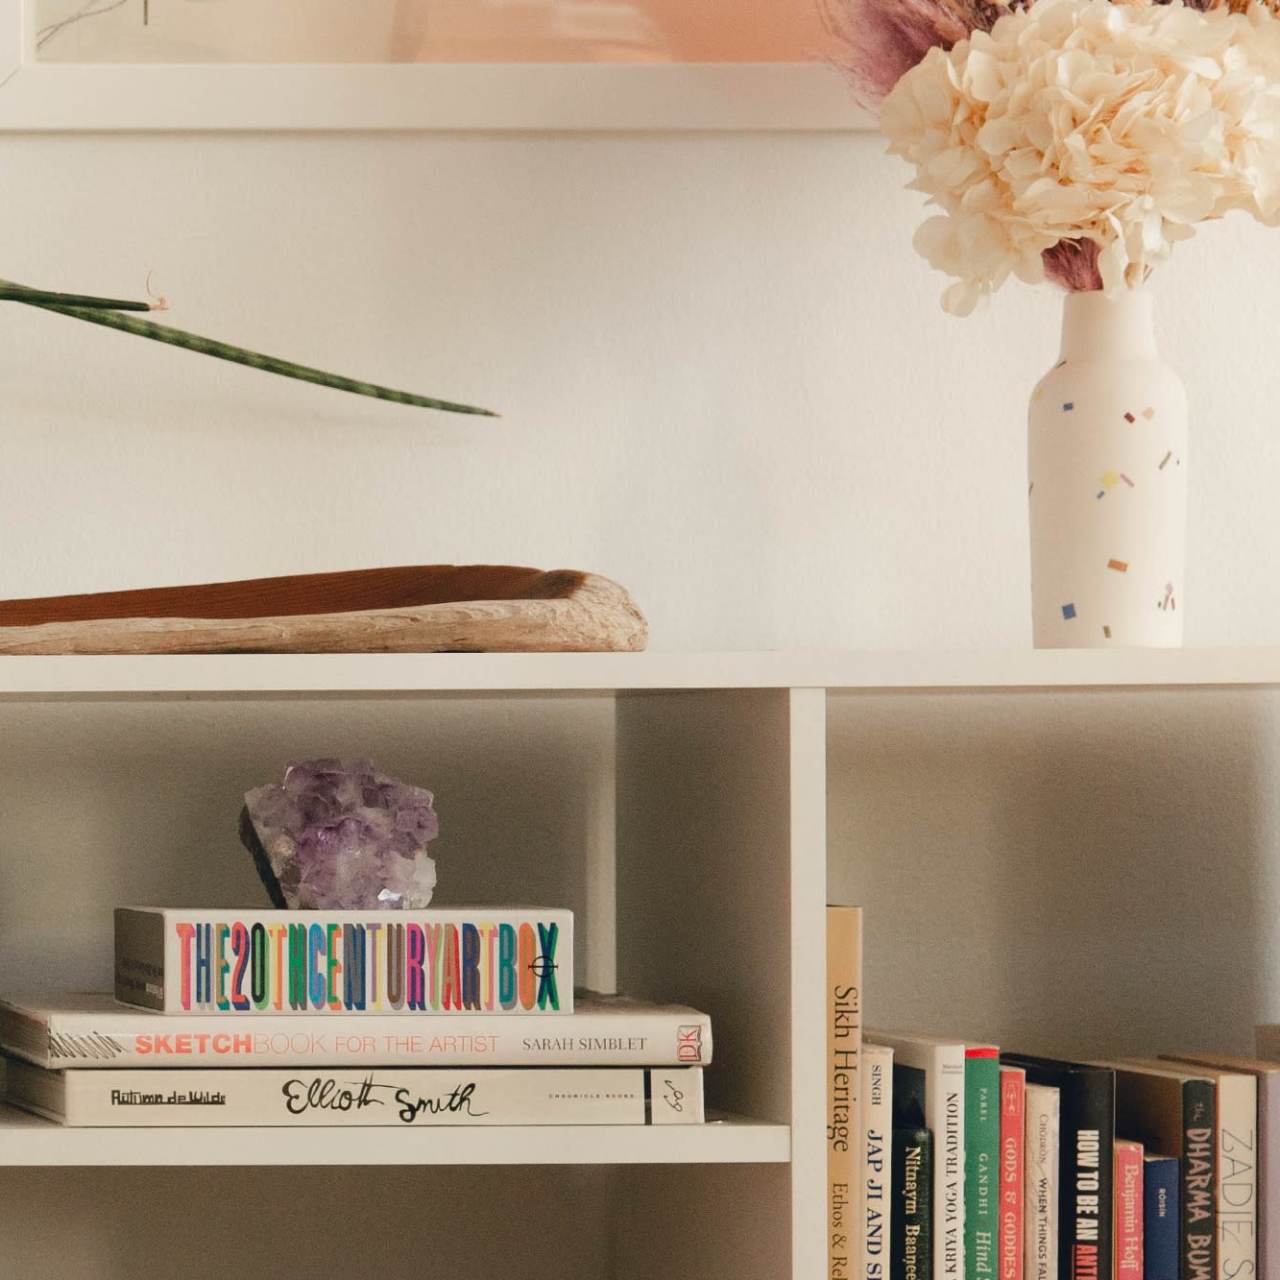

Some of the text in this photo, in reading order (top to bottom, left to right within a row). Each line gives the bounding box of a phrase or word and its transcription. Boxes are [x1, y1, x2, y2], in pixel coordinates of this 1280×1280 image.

[135, 1033, 500, 1054] SKETCHBOOK FOR THE ARTIST
[522, 1038, 647, 1051] SARAH SIMBLET
[827, 985, 859, 1153] Sikh Heritage
[281, 1073, 489, 1122] Elliott Smith
[867, 1129, 883, 1172] JAP
[1077, 1130, 1099, 1168] HOW
[866, 1178, 883, 1200] JI
[1076, 1171, 1098, 1191] TO
[1185, 1127, 1212, 1223] DHARMA
[1221, 1129, 1254, 1242] ZADIE
[1076, 1195, 1098, 1215] BE
[866, 1207, 882, 1255] AND
[1076, 1218, 1098, 1241] AN
